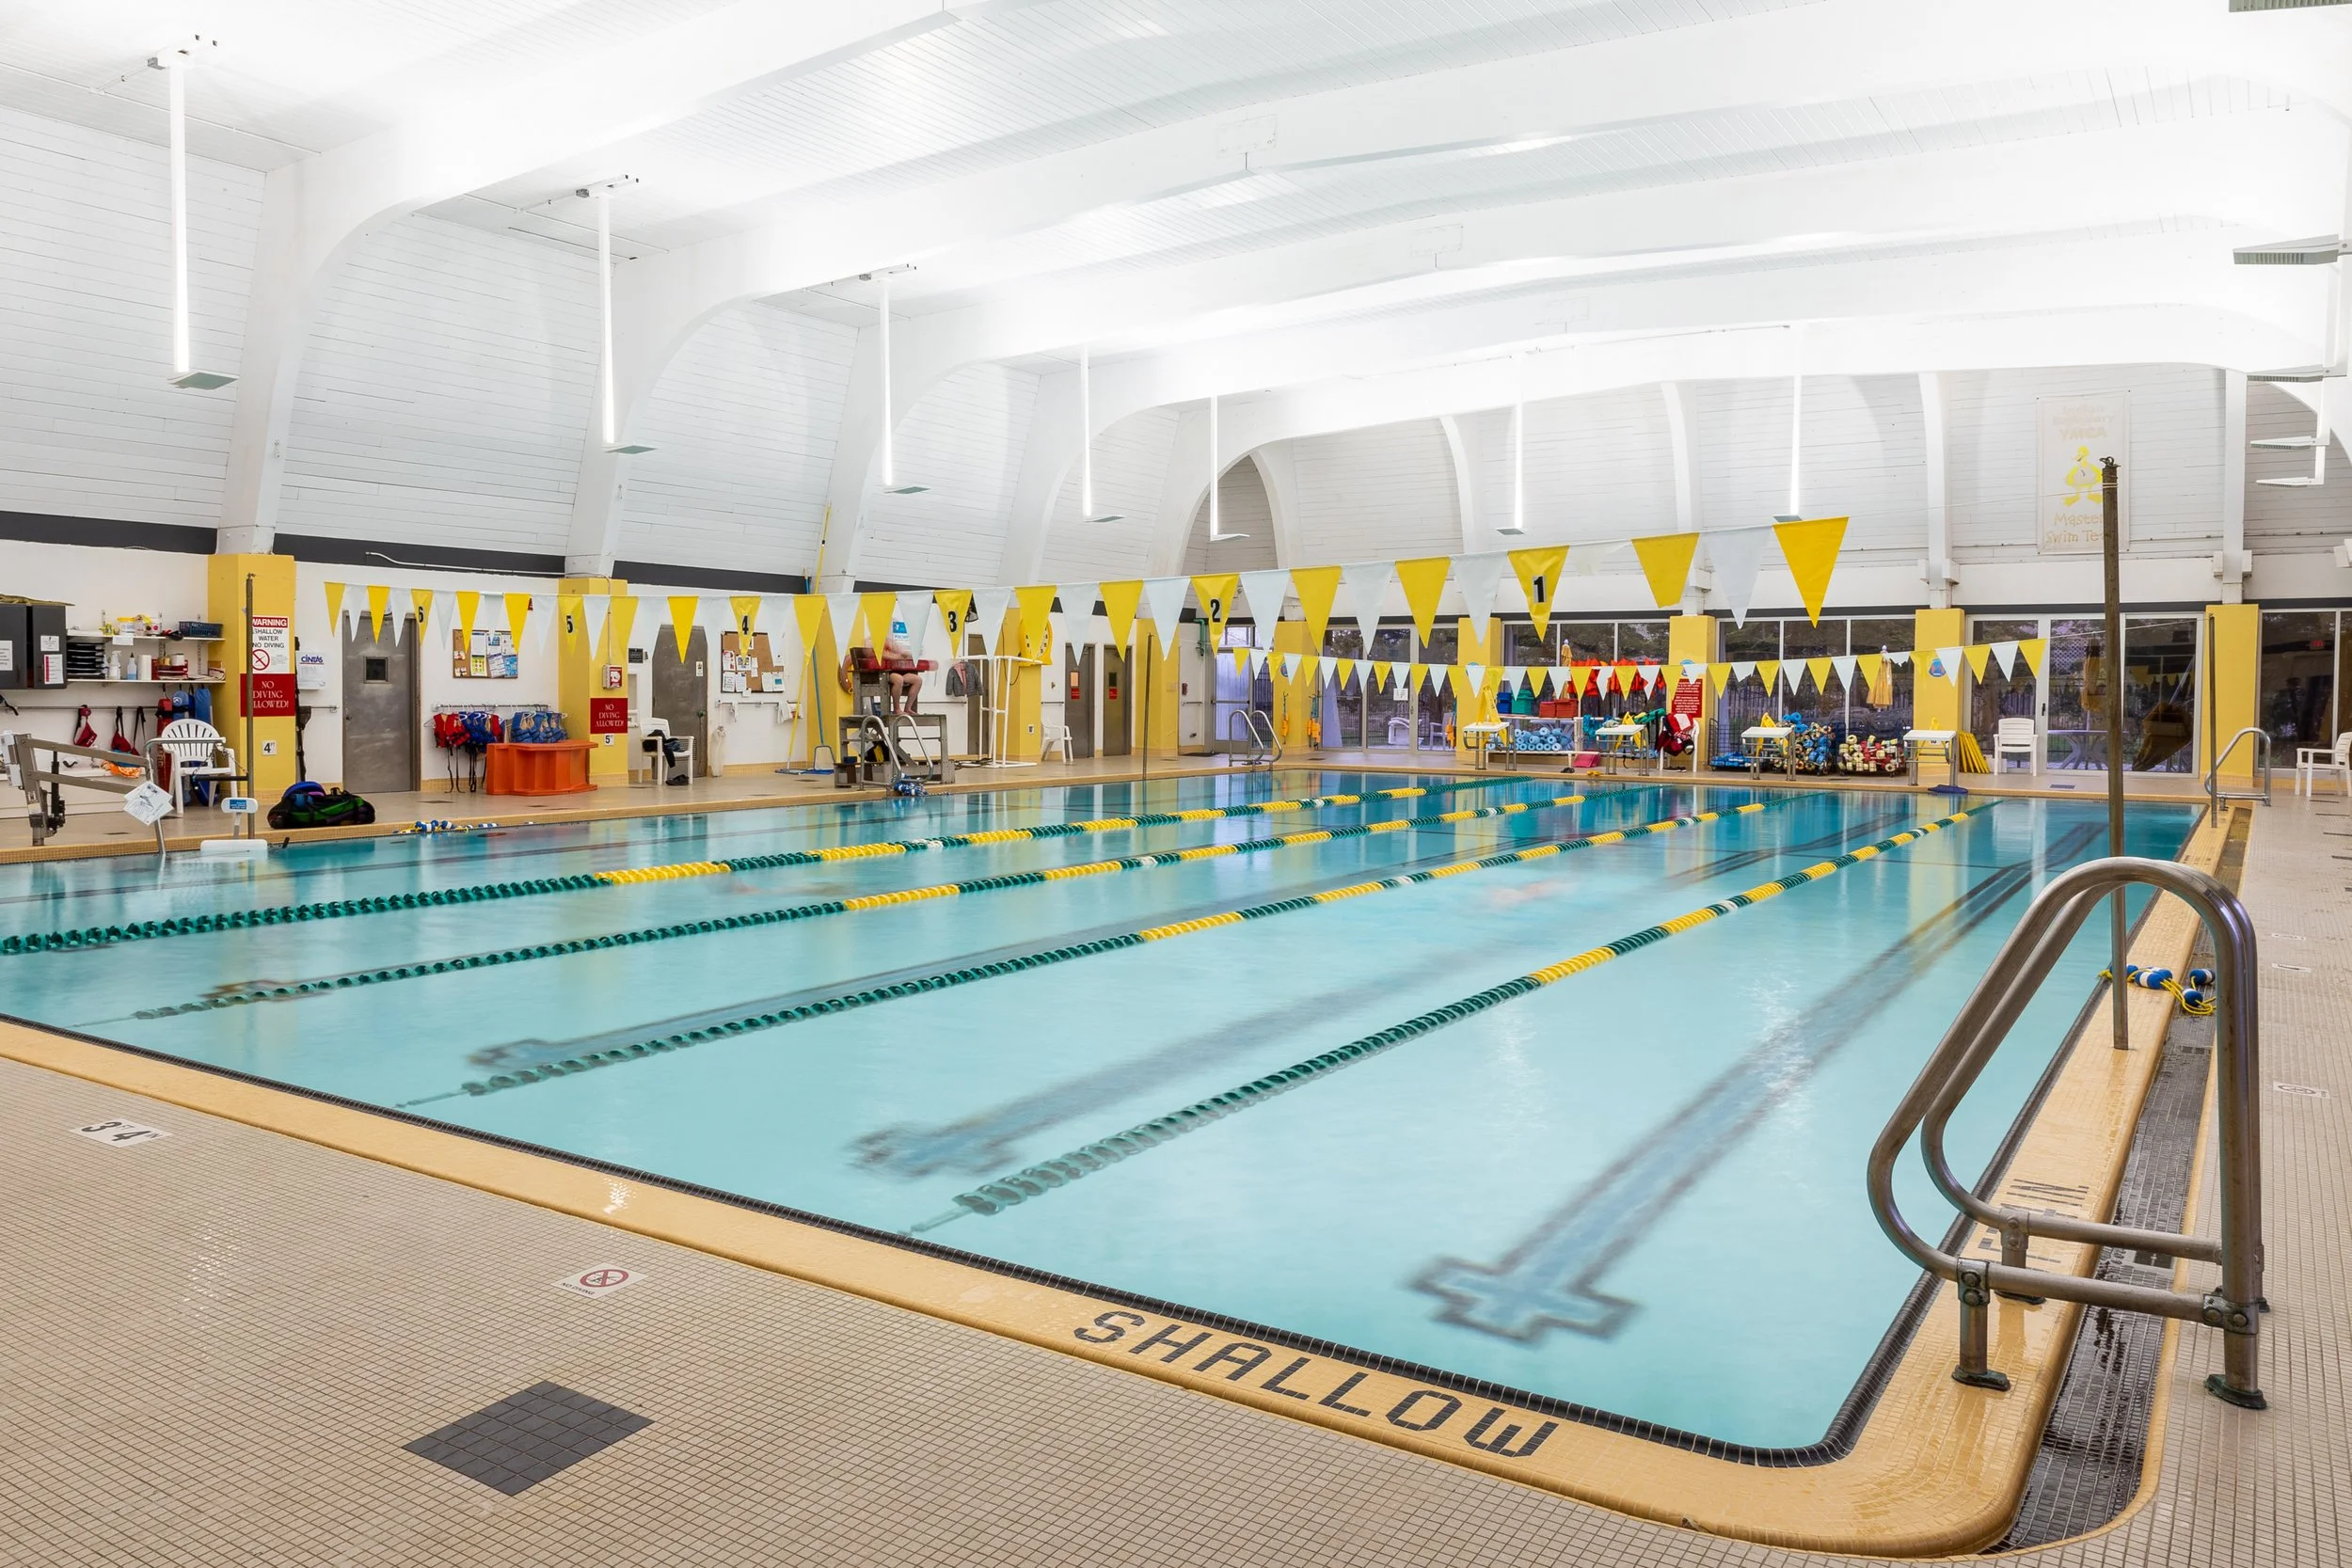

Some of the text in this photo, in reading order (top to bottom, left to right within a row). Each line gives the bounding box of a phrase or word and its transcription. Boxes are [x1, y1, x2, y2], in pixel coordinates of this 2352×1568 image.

[2045, 530, 2079, 544] Swim
[1534, 576, 1545, 603] 1
[418, 606, 424, 624] 6
[1210, 598, 1221, 623] 2
[566, 614, 574, 634] 5
[741, 615, 750, 636] 4
[947, 610, 958, 633] 3
[262, 680, 275, 689] NO
[252, 690, 283, 699] DIVING
[253, 700, 289, 708] LLOWED!
[263, 742, 271, 753] 4
[605, 735, 611, 744] 5
[81, 1121, 122, 1132] 3
[111, 1131, 151, 1142] 4
[572, 1285, 596, 1295] DIVING
[1073, 1309, 1560, 1459] SHALLOW
